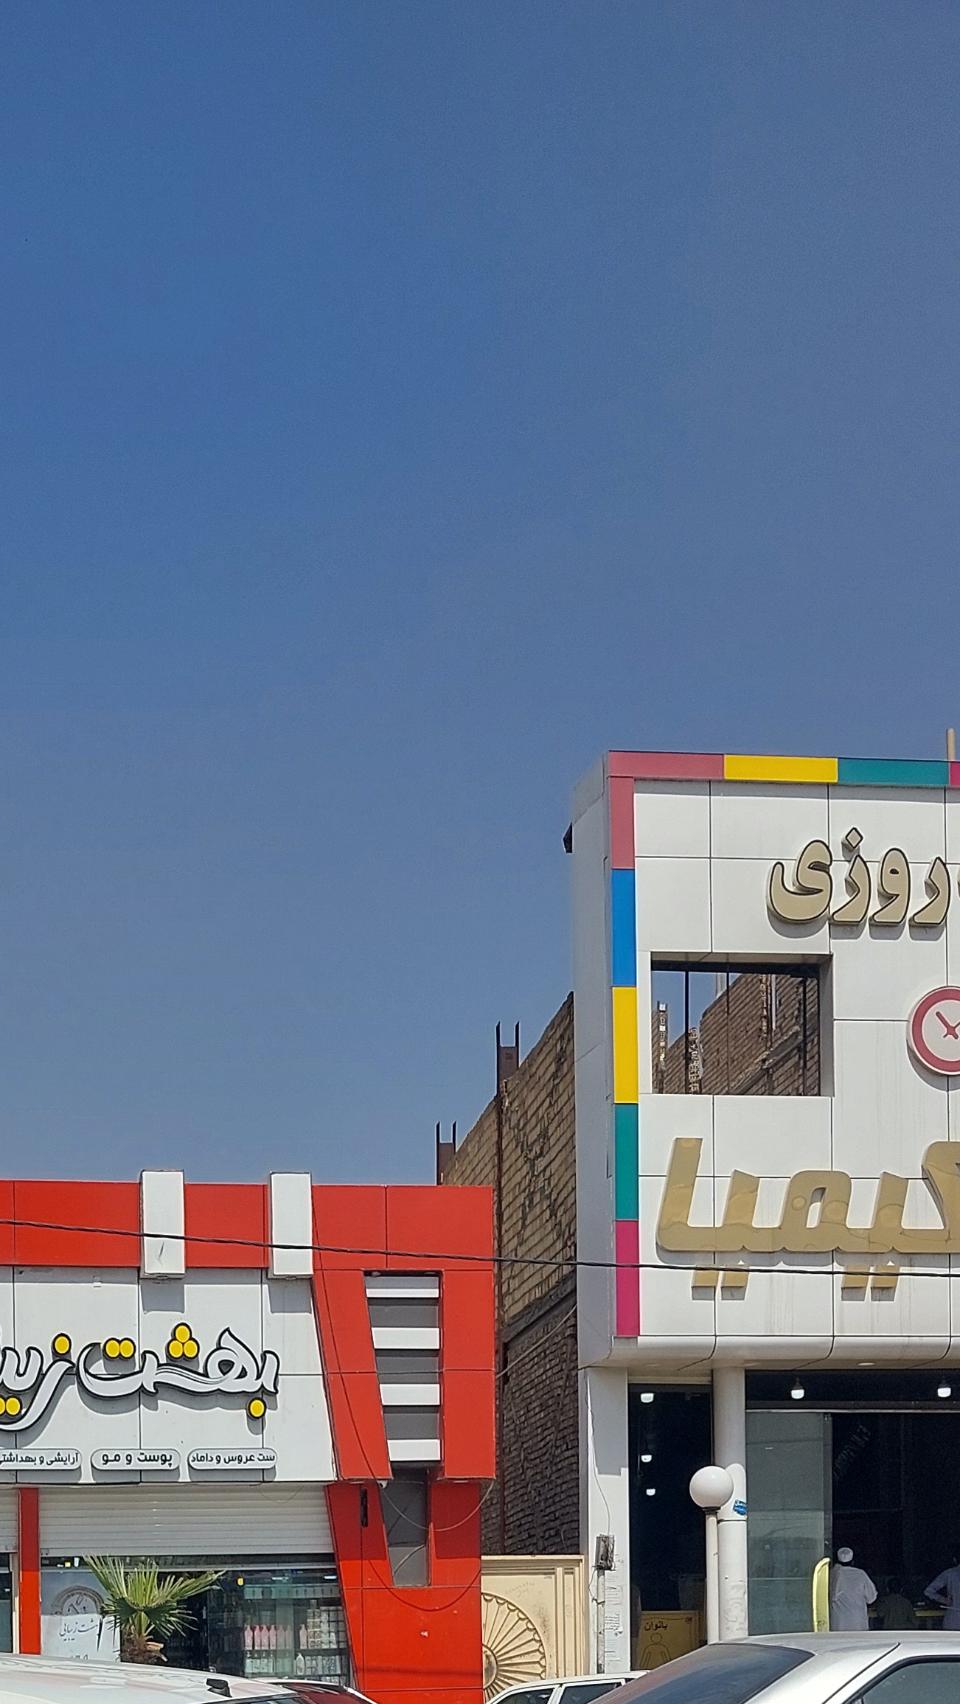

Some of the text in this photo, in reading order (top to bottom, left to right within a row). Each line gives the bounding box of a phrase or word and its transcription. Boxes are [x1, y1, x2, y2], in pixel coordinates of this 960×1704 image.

[768, 826, 951, 925] روزی
[76, 1322, 279, 1419] بهشت
[39, 1455, 46, 1465] و
[46, 1451, 80, 1466] آرایشی
[101, 1453, 173, 1468] پوست و مو
[191, 1452, 213, 1463] داماد
[222, 1454, 254, 1466] عروس
[257, 1453, 275, 1462] ست
[644, 1620, 668, 1631] بانوان
